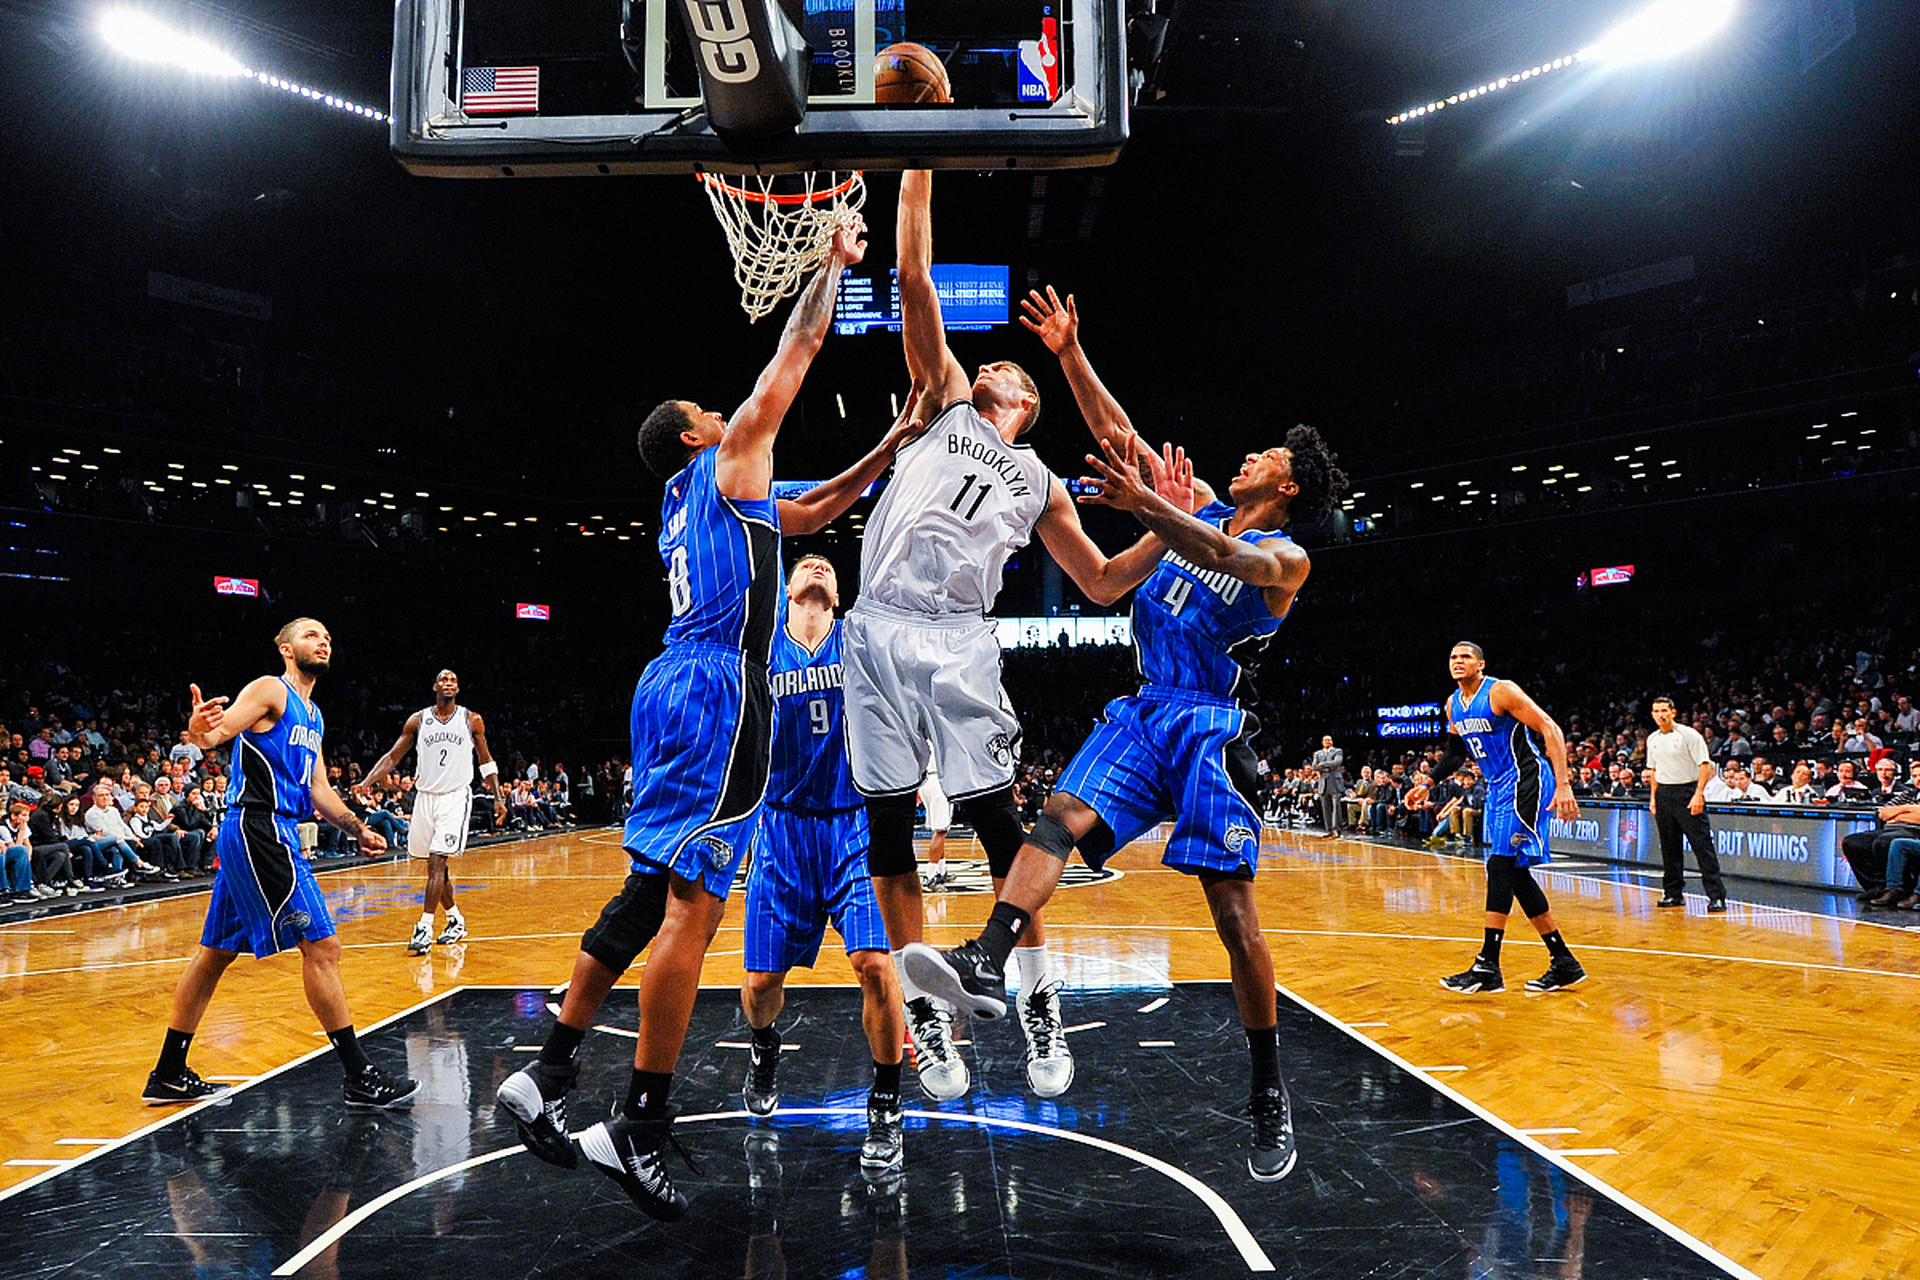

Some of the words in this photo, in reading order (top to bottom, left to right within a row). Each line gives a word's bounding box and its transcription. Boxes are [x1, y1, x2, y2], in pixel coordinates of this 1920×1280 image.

[1022, 84, 1045, 97] NBA
[948, 433, 1031, 498] BROOKLYN
[949, 474, 992, 521] 11
[669, 545, 691, 617] 8
[1163, 576, 1194, 617] 4
[809, 698, 829, 735] 9
[439, 748, 448, 767] 2
[1467, 737, 1487, 759] 12
[1550, 818, 1573, 839] TOTAL
[1575, 820, 1600, 841] ZERO
[1718, 829, 1744, 857] BUT
[1747, 832, 1809, 863] WIIINGS
